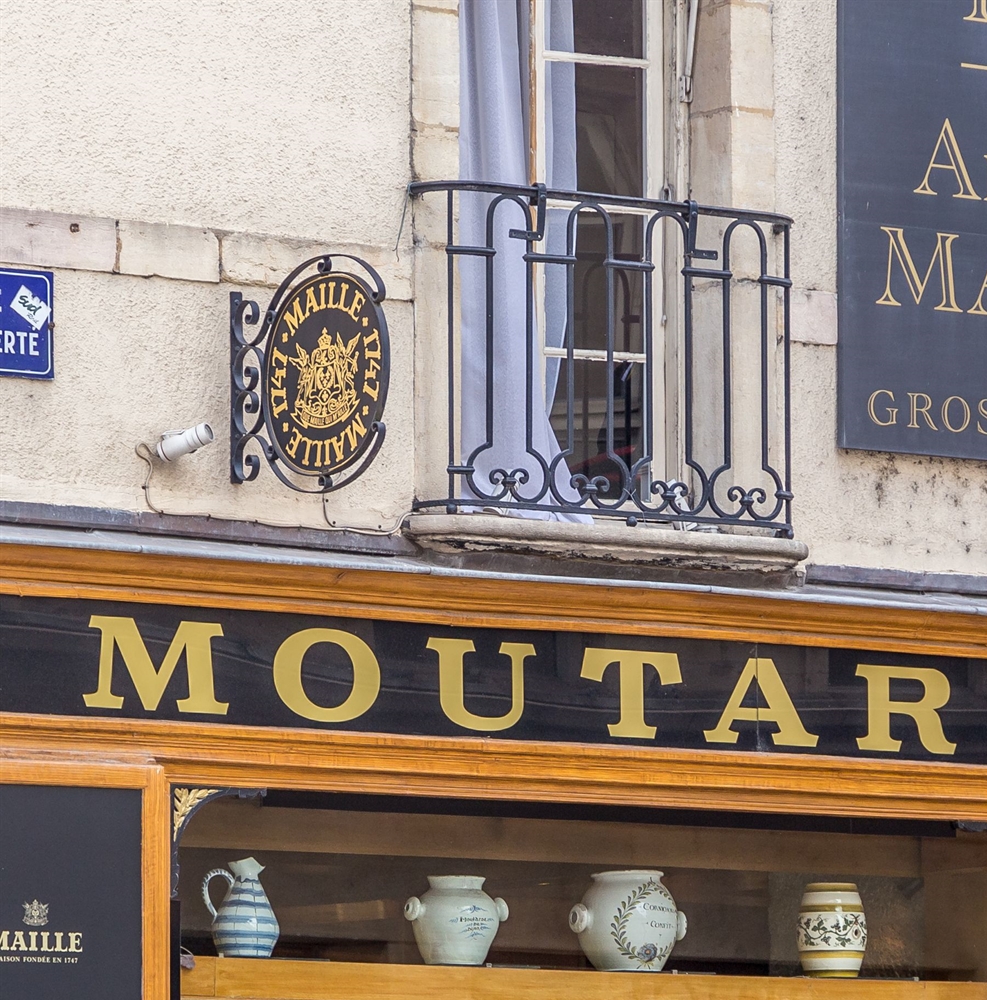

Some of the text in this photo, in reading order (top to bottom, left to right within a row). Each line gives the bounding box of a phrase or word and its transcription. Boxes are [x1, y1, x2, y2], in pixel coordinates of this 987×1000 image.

[283, 281, 366, 337] MAILLE
[0, 325, 39, 356] RTÉ
[285, 412, 368, 467] MAILLE
[23, 955, 51, 963] FONDÉE
